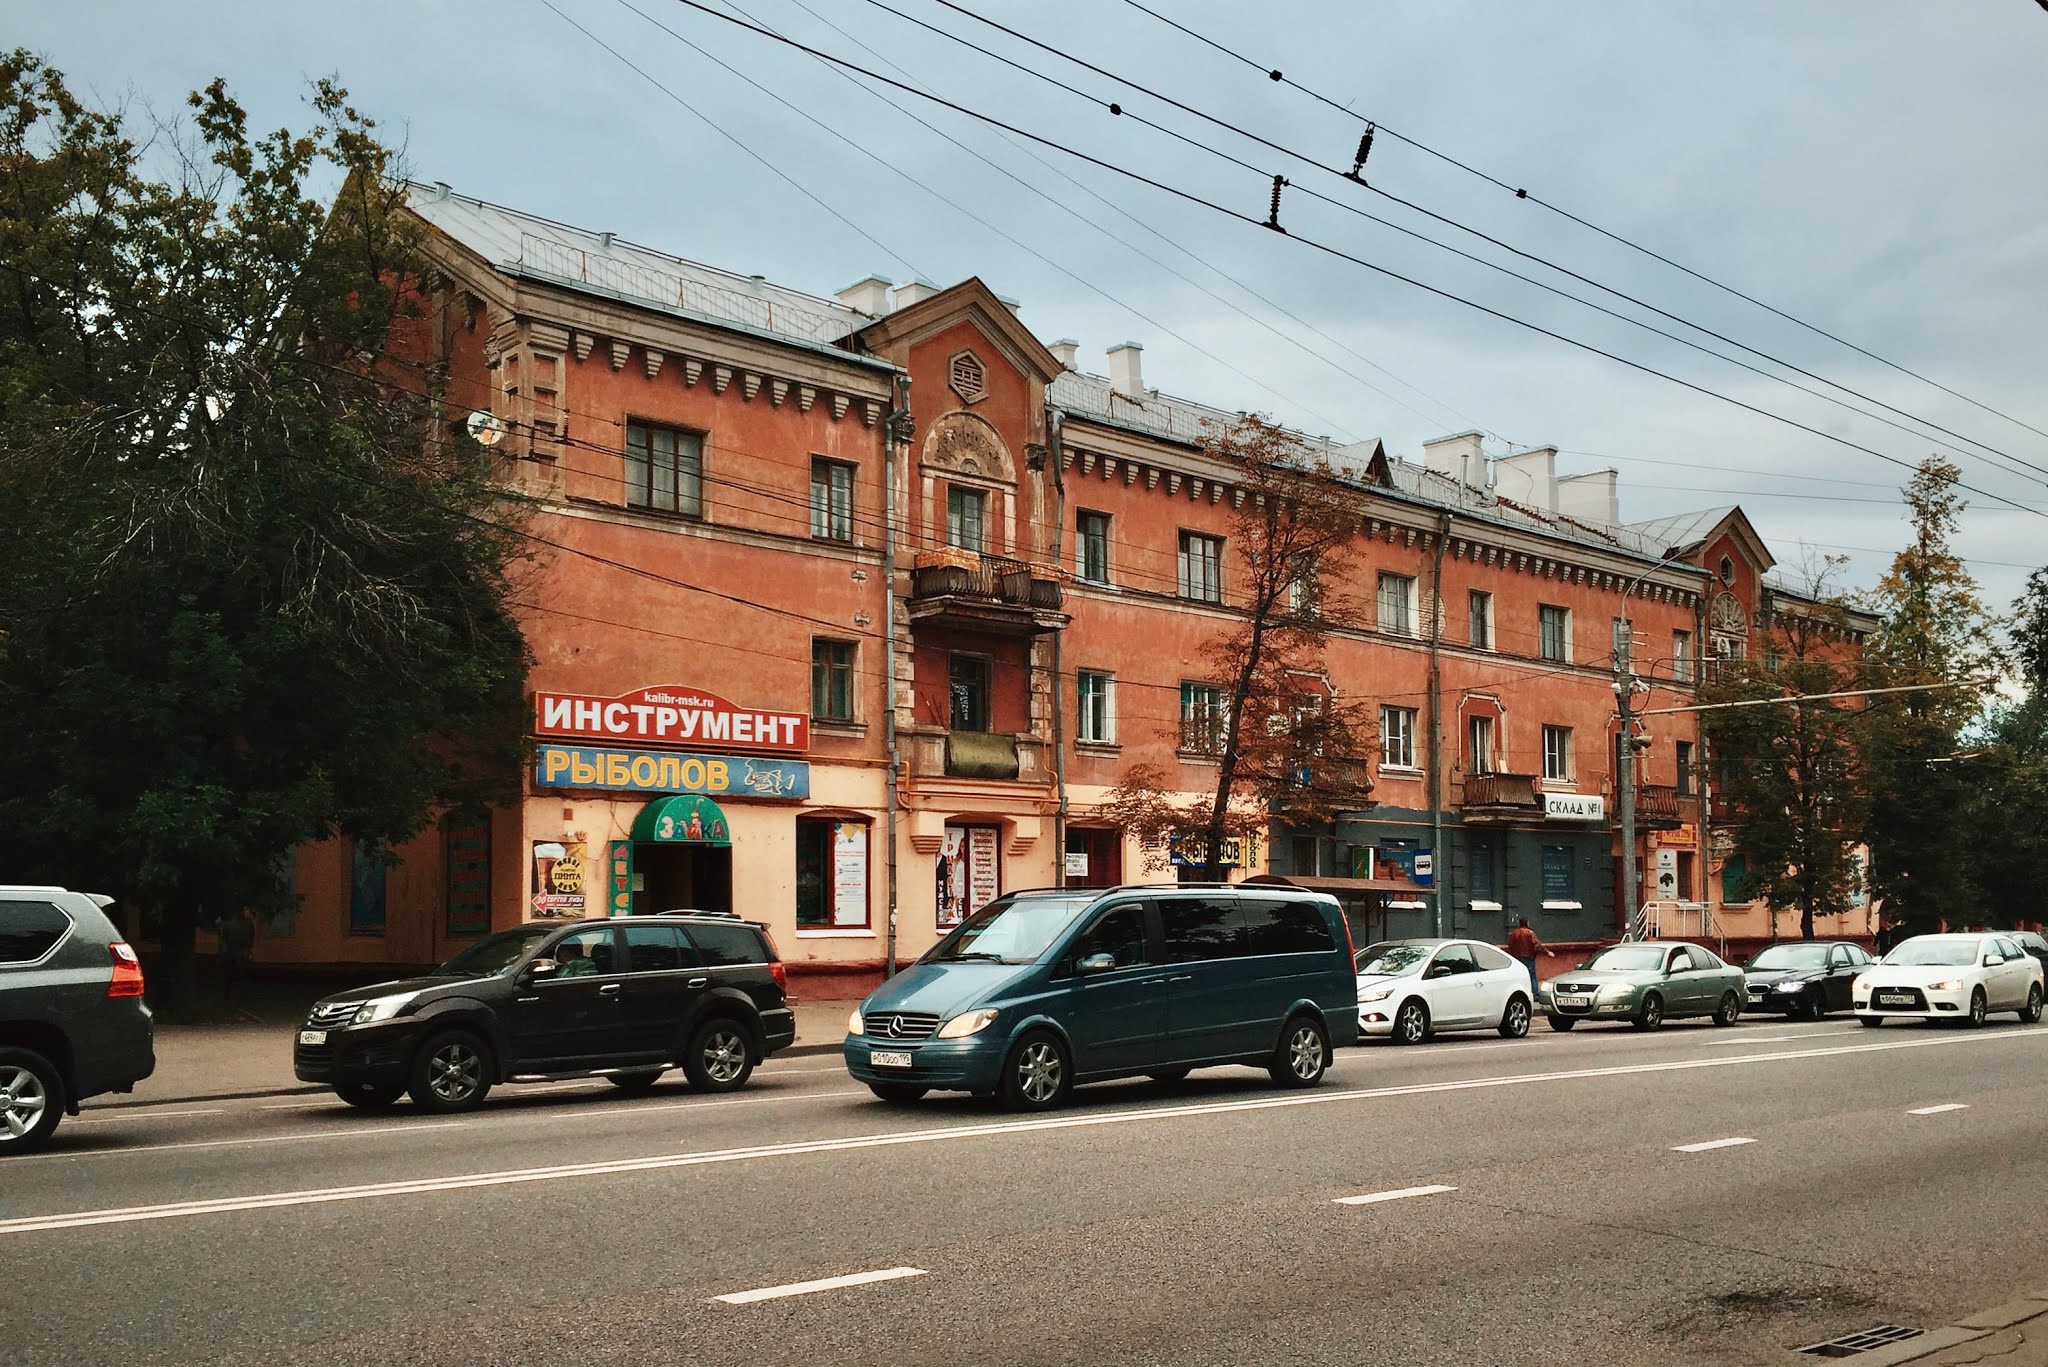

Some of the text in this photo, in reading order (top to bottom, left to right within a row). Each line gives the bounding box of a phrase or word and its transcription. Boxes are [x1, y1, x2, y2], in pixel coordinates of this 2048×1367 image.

[644, 691, 715, 708] kalibr-msk.ru
[544, 697, 801, 745] ИНСТРУМЕНТ
[545, 749, 731, 792] РЫБОЛОВ
[1549, 800, 1601, 816] СКЛАД №1
[554, 873, 581, 881] ПИНТА
[946, 832, 955, 919] ТРИКОТАЖ
[536, 896, 547, 904] 30
